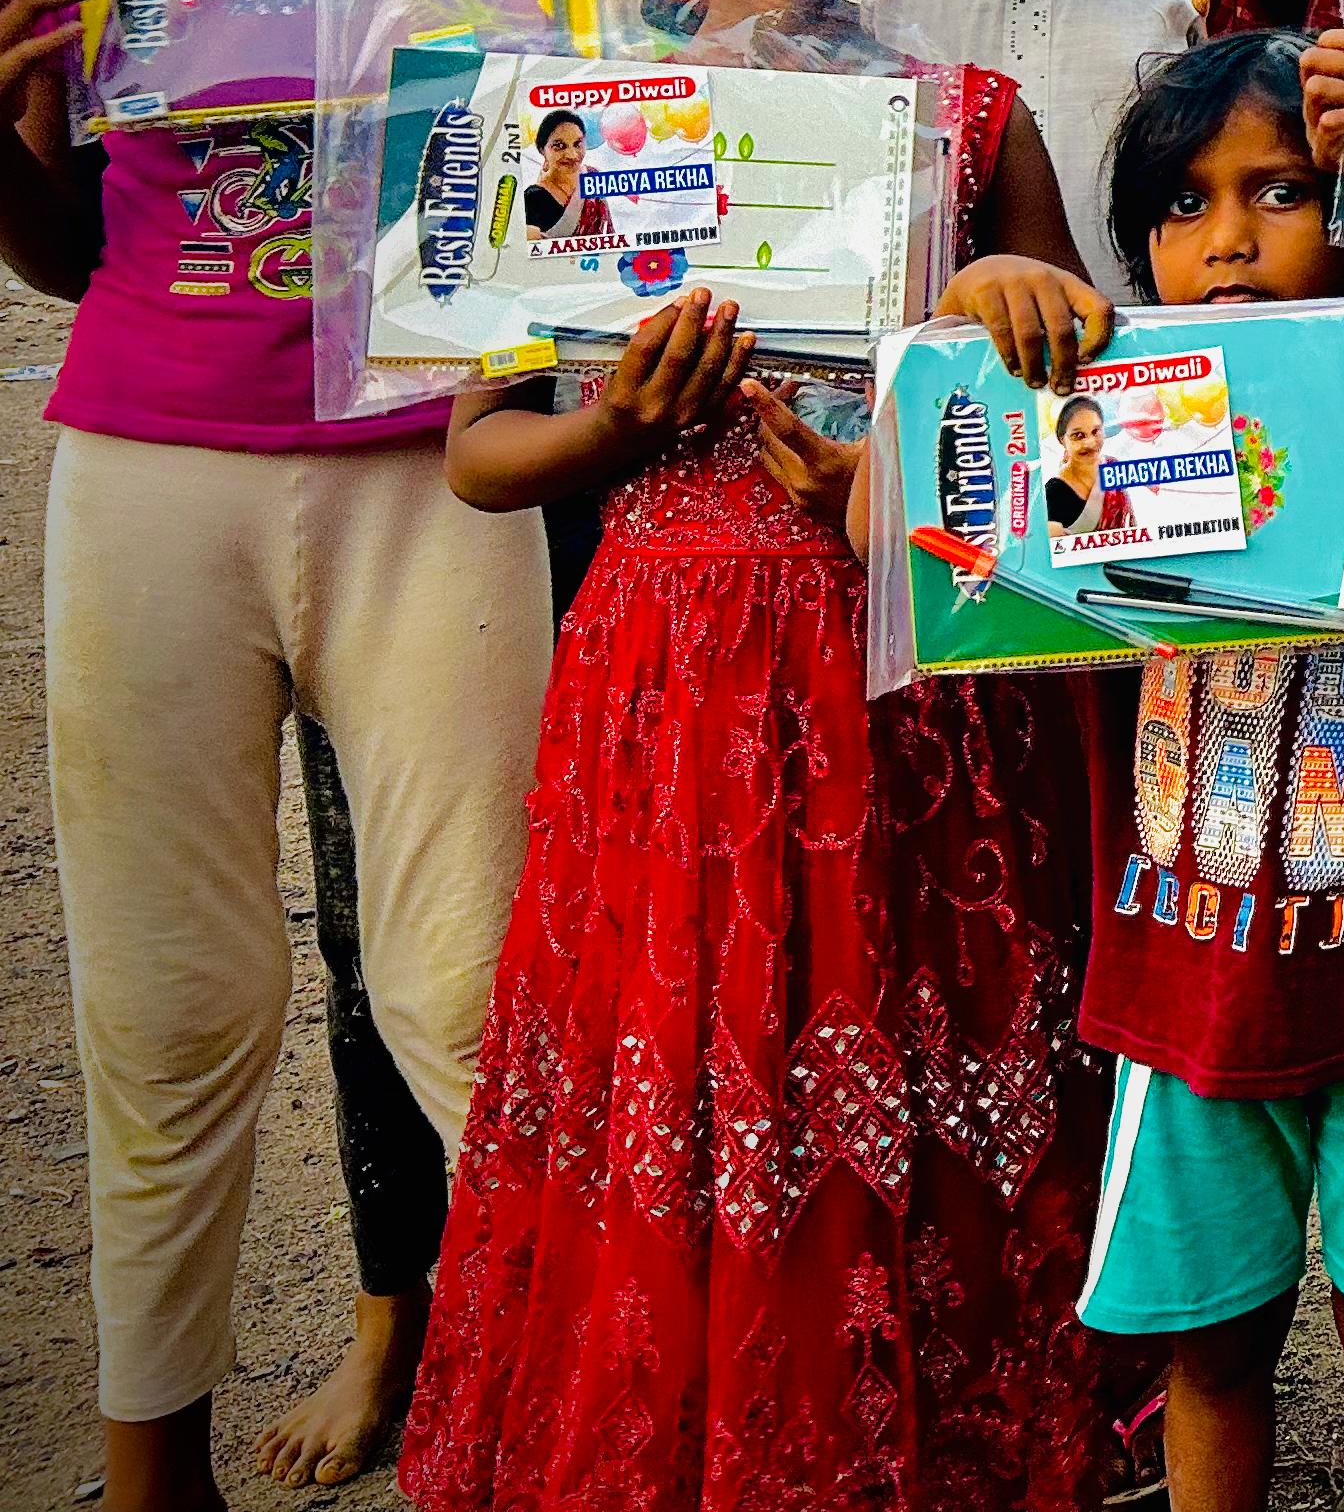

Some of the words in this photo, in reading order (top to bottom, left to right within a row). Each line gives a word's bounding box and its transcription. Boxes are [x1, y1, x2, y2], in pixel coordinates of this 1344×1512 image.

[538, 86, 612, 108] Happy
[618, 79, 686, 99] Diwali
[424, 112, 484, 220] Friends
[584, 173, 651, 195] BHAGYA
[654, 167, 709, 189] REKHA
[491, 183, 510, 240] ORIGINAL
[420, 226, 473, 287] Best
[548, 234, 630, 255] AARSHA
[635, 226, 718, 246] FOUNDATION
[1074, 371, 1128, 392] appy
[1133, 358, 1202, 383] Diwali
[940, 402, 995, 516] Friends
[1104, 461, 1172, 487] BHAGYA
[1174, 454, 1230, 478] REKHA
[1013, 465, 1026, 529] ORIGINAL
[1071, 528, 1152, 551] AARSHA
[1158, 517, 1239, 539] FOUNDATION
